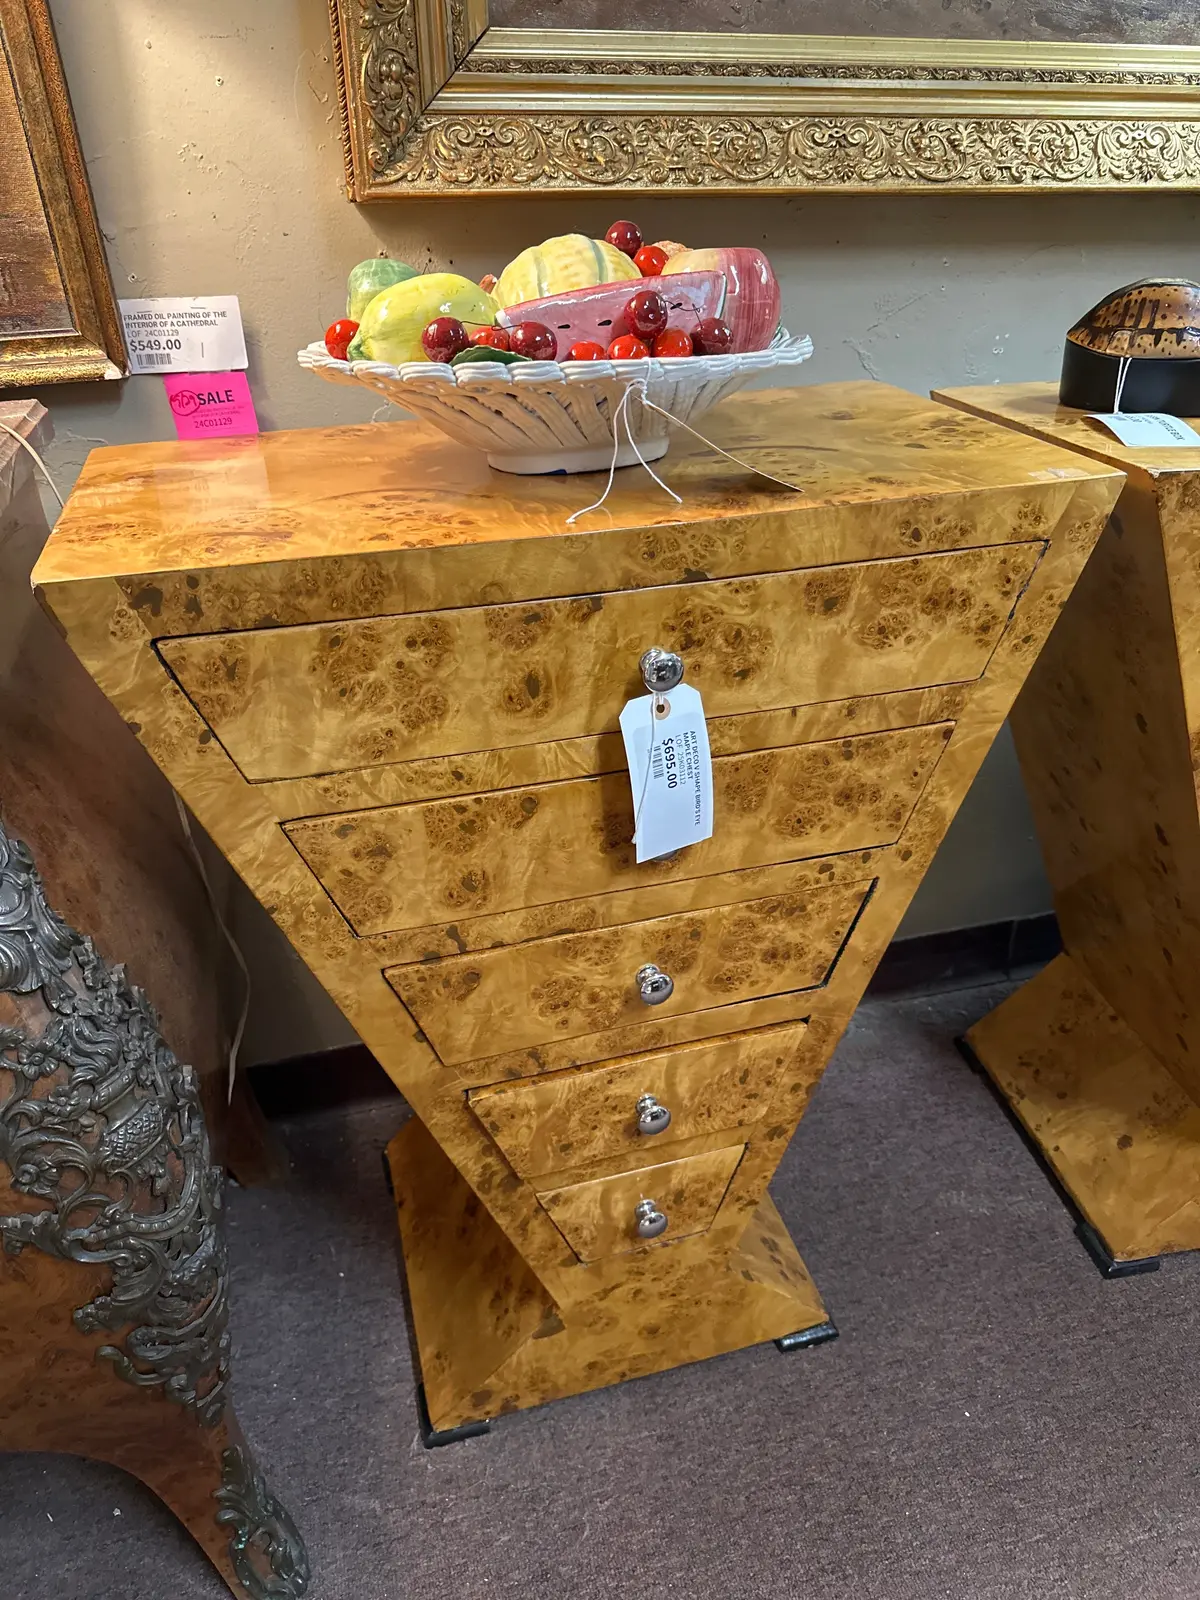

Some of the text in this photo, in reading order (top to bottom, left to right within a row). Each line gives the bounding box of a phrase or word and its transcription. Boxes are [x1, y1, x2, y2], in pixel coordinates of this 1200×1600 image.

[124, 314, 153, 322] FRAMED
[167, 312, 200, 320] PAINTING
[202, 311, 211, 319] OF
[213, 310, 227, 318] THE
[125, 321, 158, 329] INTERIOR
[159, 320, 169, 328] OF
[177, 319, 218, 327] CATHEDRAL
[127, 329, 179, 338] LOF 24C01129
[129, 338, 182, 352] $549.00
[197, 389, 235, 405] SALE
[194, 417, 233, 429] 24C01129
[675, 735, 683, 749] LOF
[689, 730, 698, 745] ART
[683, 732, 693, 780] MAPLE CHEST
[691, 745, 699, 764] DECO
[662, 737, 678, 789] $695.00
